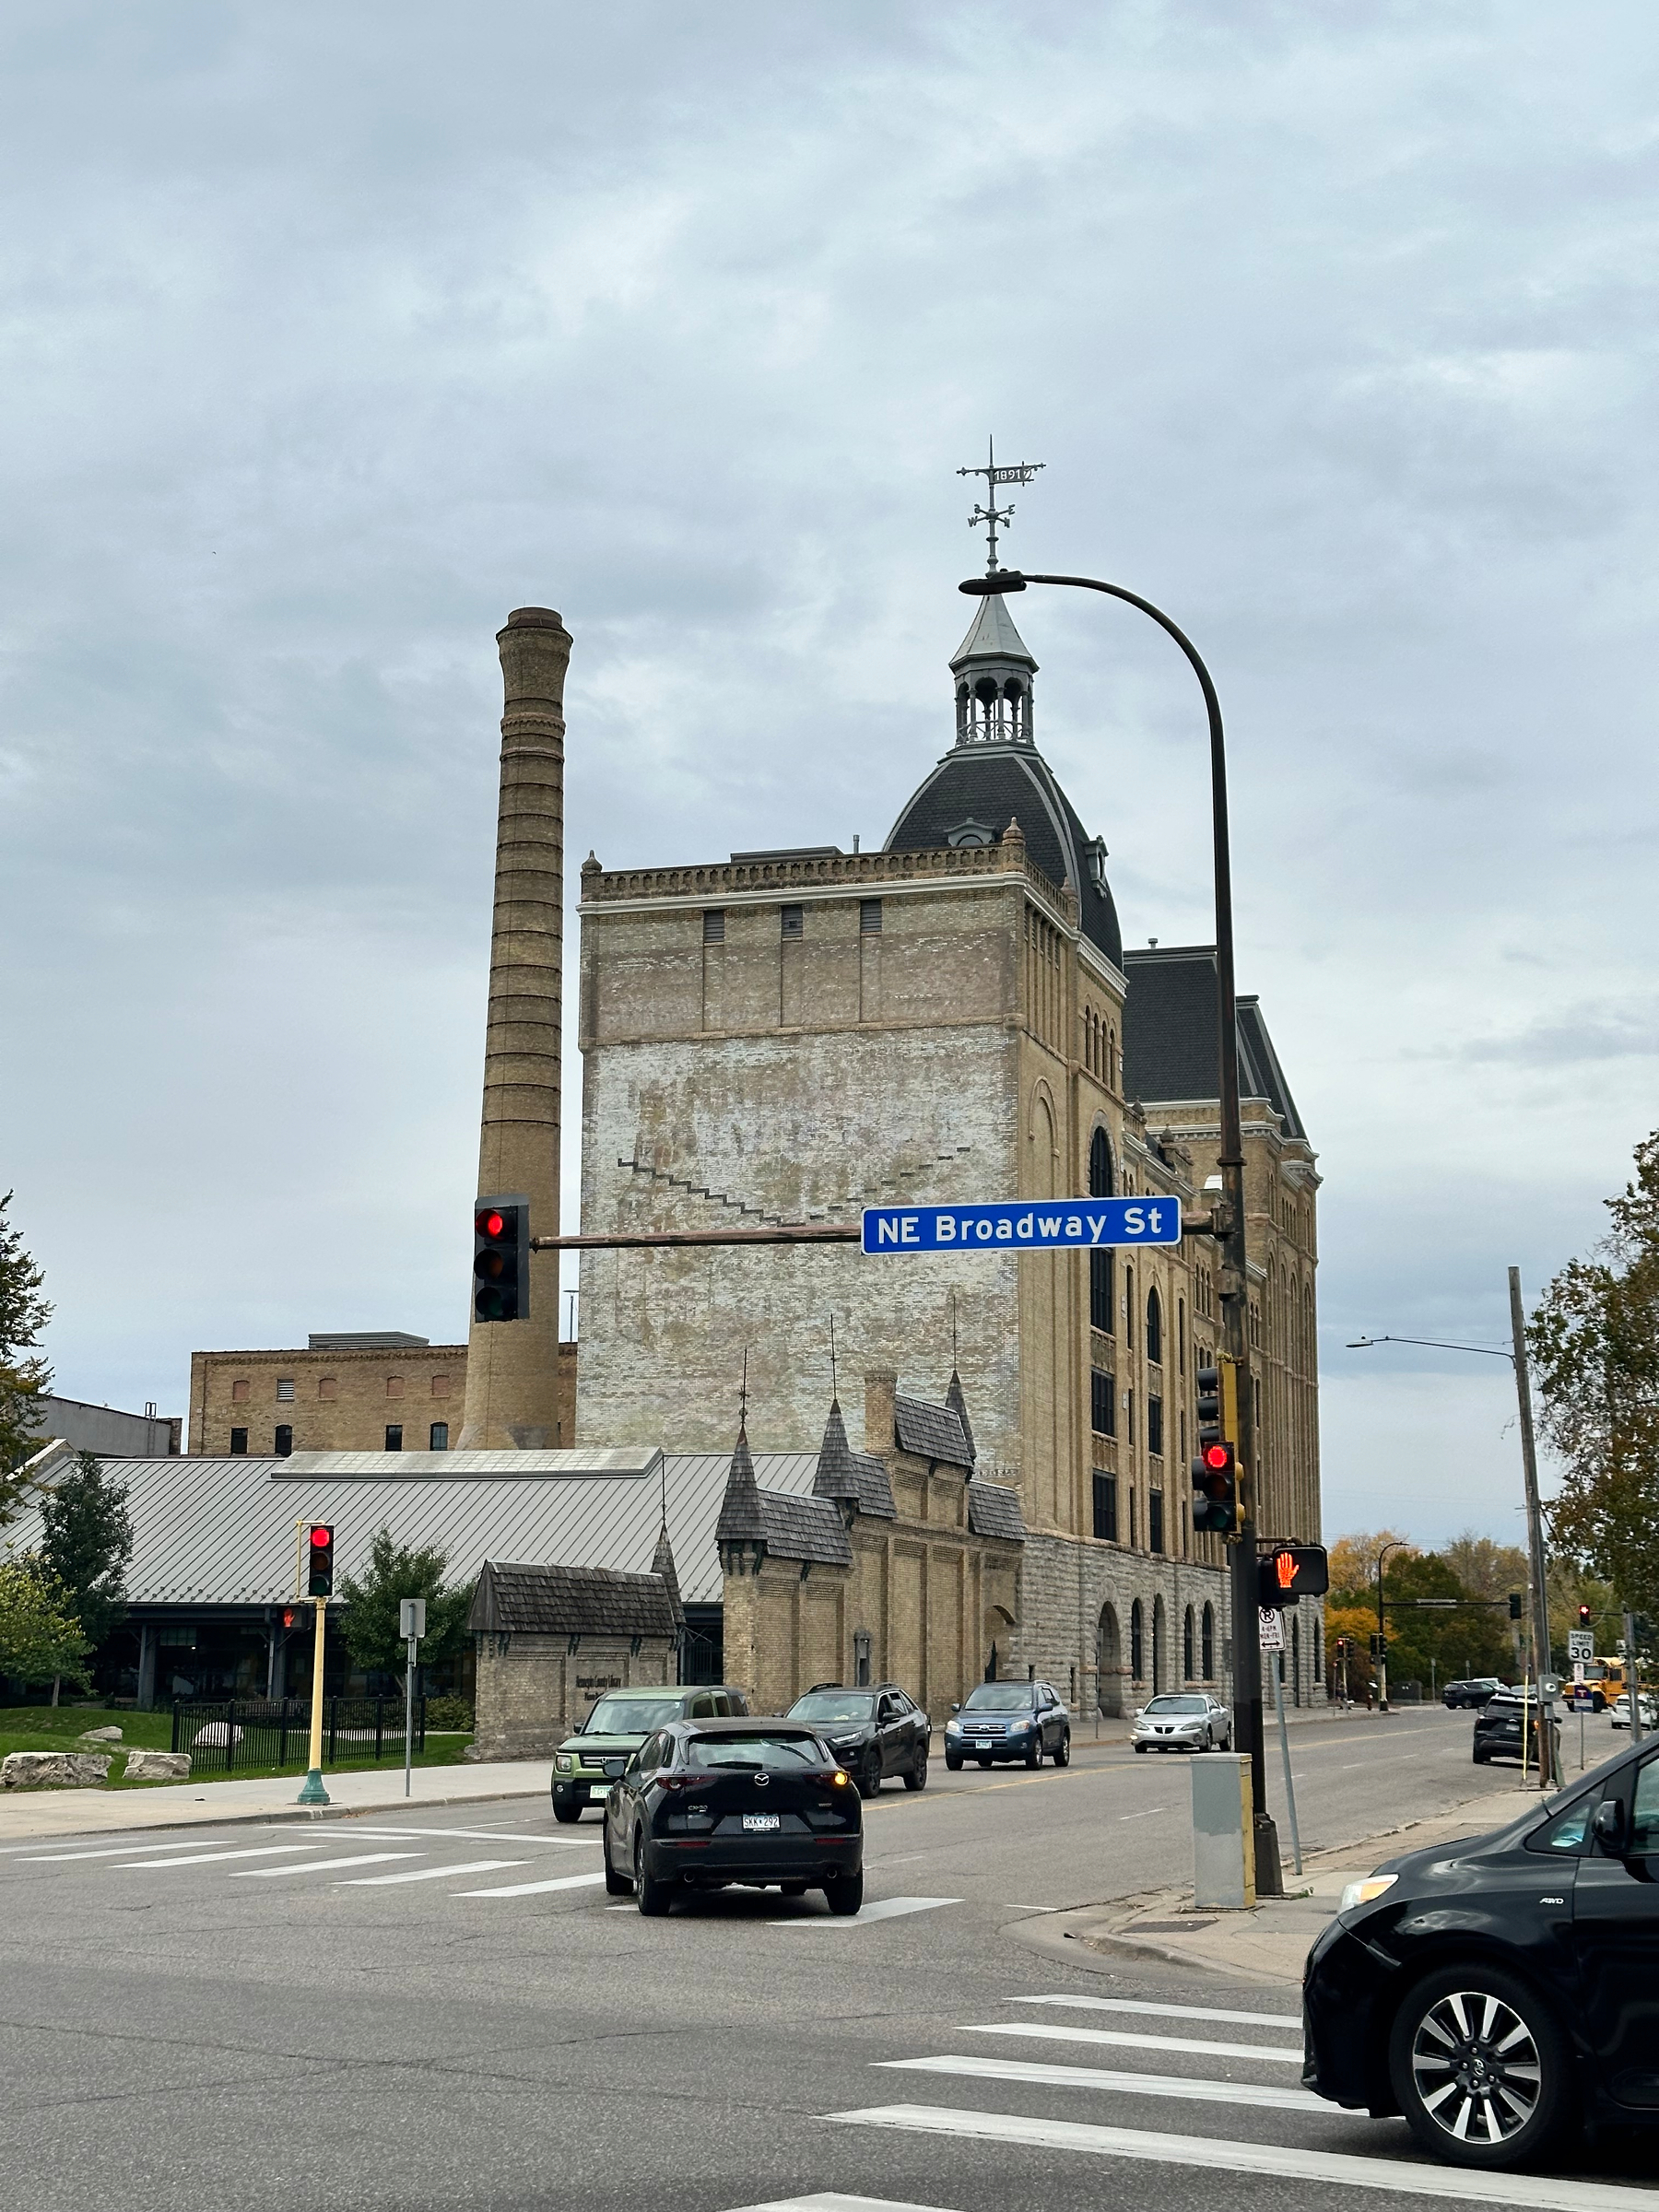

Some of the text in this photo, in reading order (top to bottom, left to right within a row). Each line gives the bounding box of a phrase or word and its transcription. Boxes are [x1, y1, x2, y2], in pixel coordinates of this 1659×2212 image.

[994, 469, 1021, 481] 1891
[877, 1207, 1162, 1244] NE Broadway St
[1571, 1647, 1592, 1660] 30
